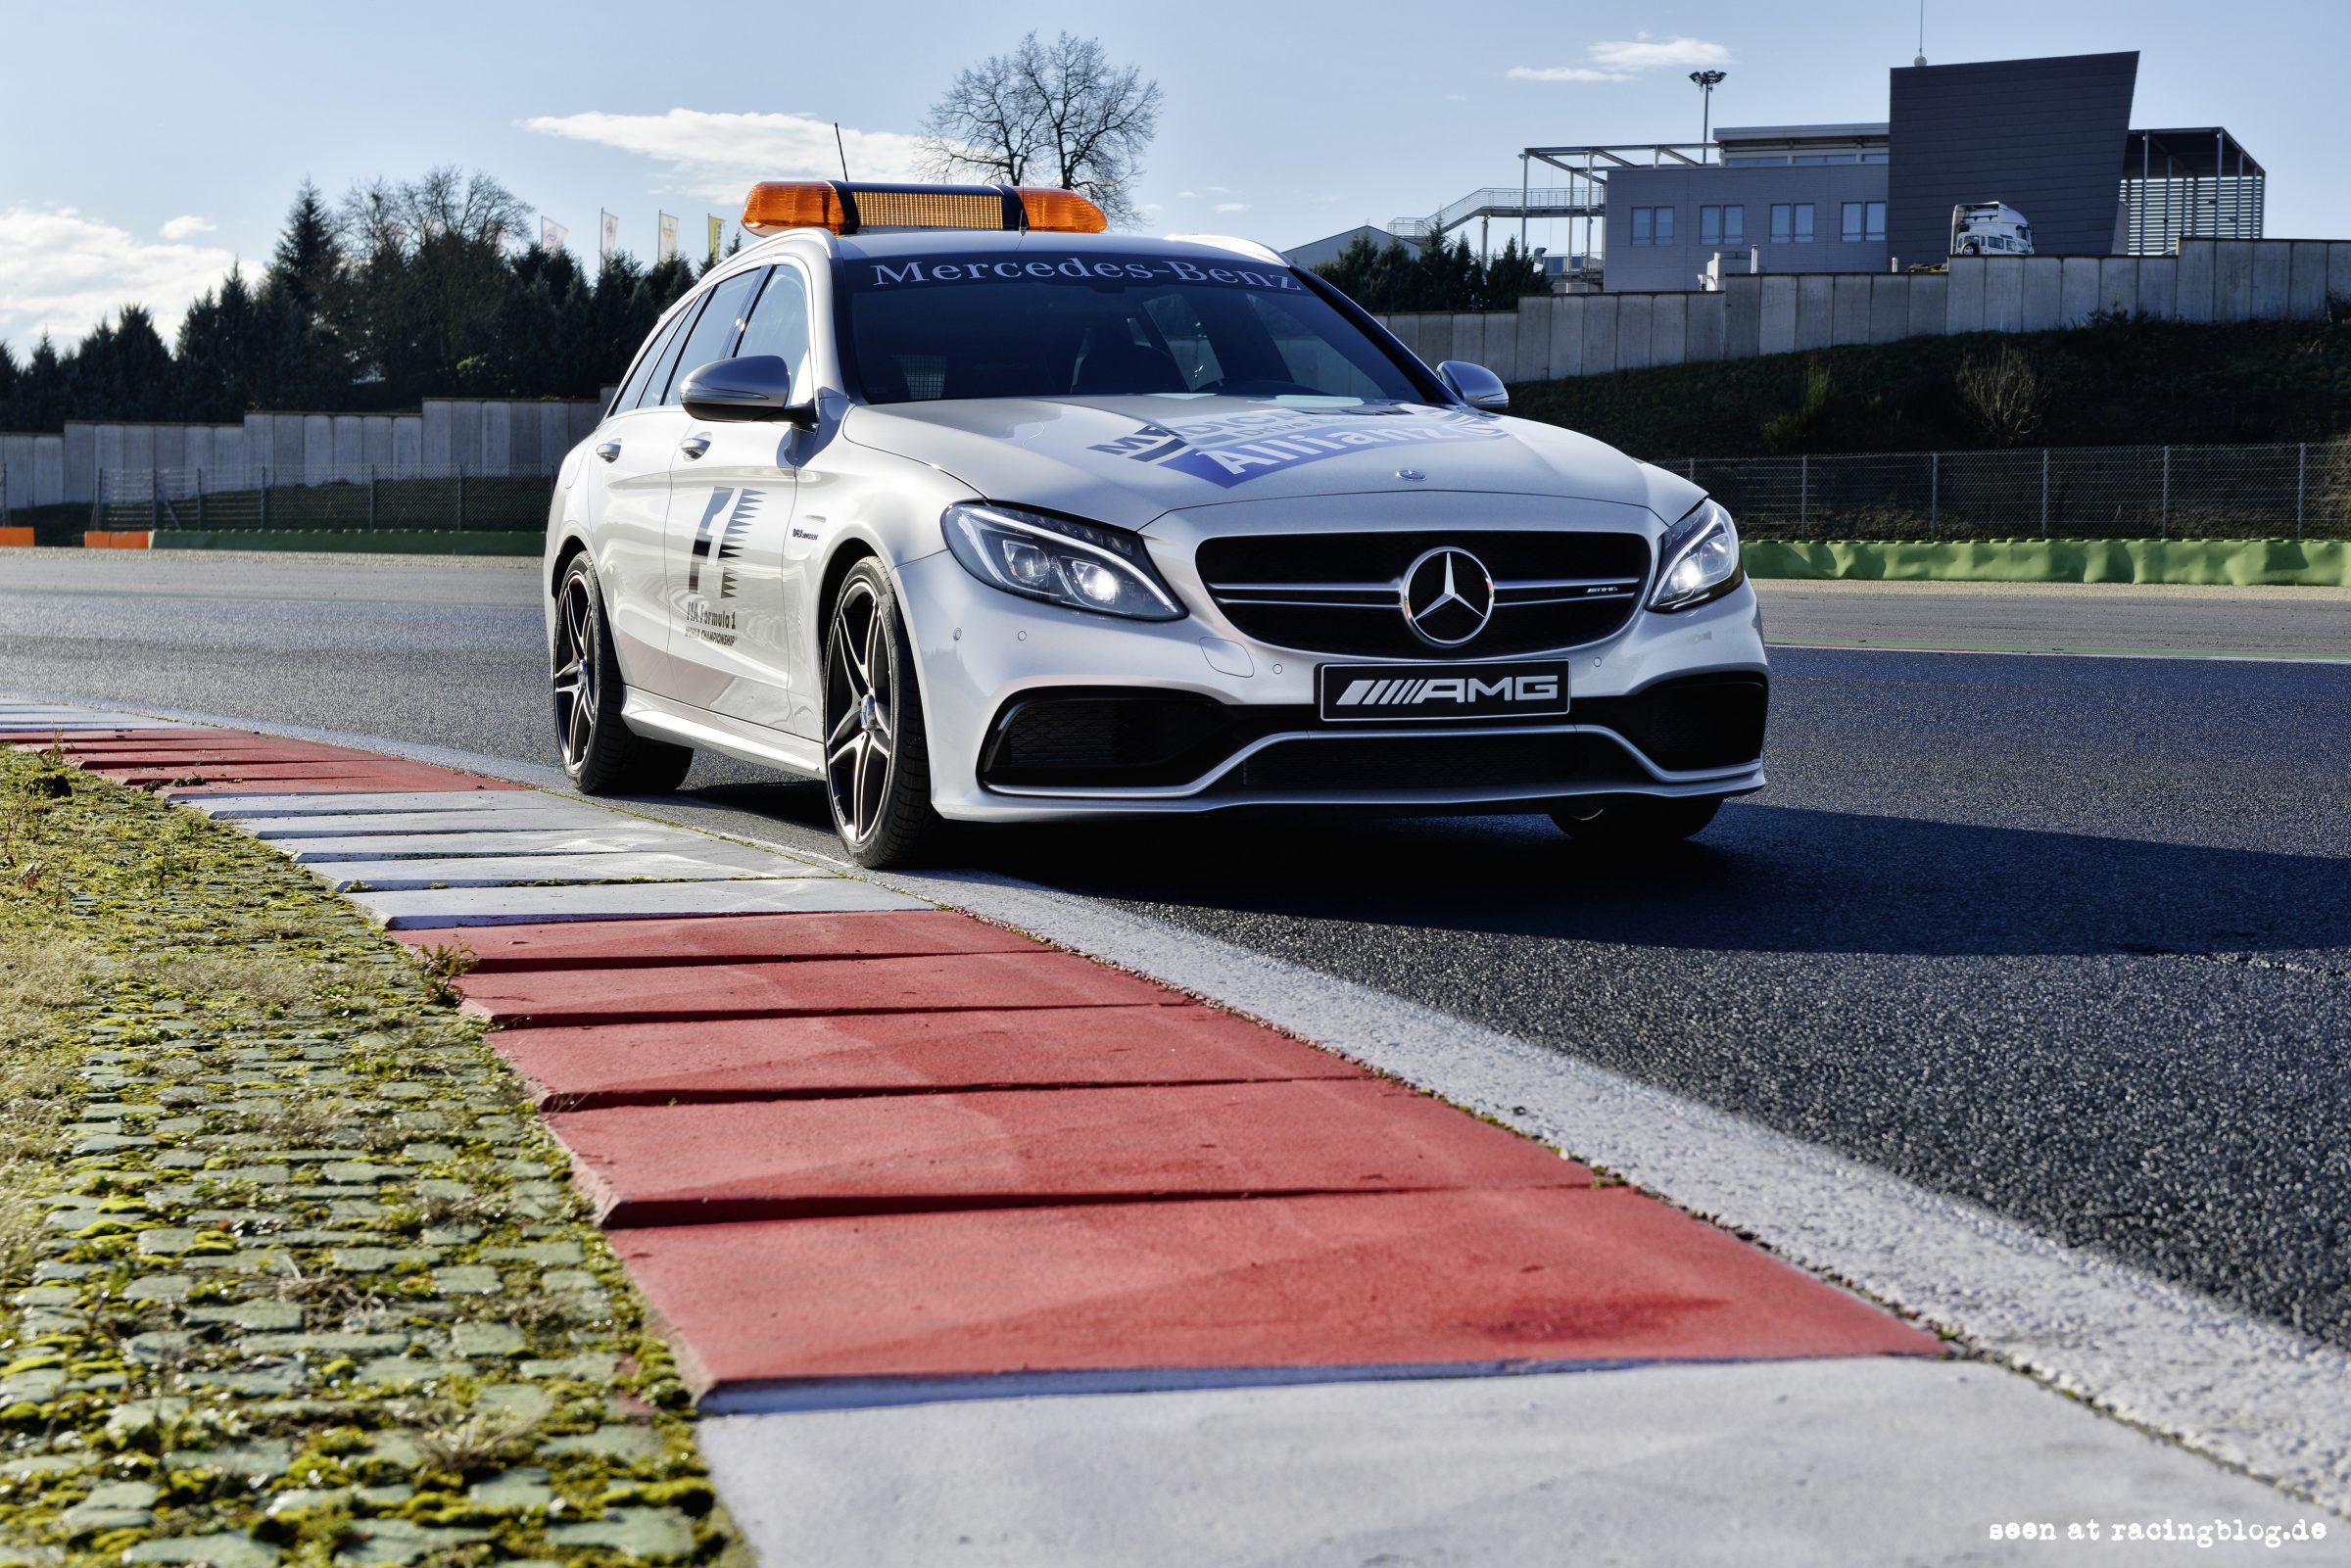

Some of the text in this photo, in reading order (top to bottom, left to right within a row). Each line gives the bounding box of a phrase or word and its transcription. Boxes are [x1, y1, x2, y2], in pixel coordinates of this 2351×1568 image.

[872, 257, 1301, 291] Mercedes-Benz
[1195, 428, 1463, 475] Allianz
[699, 603, 731, 629] Formula
[731, 610, 737, 630] 1
[1412, 675, 1559, 704] AMG
